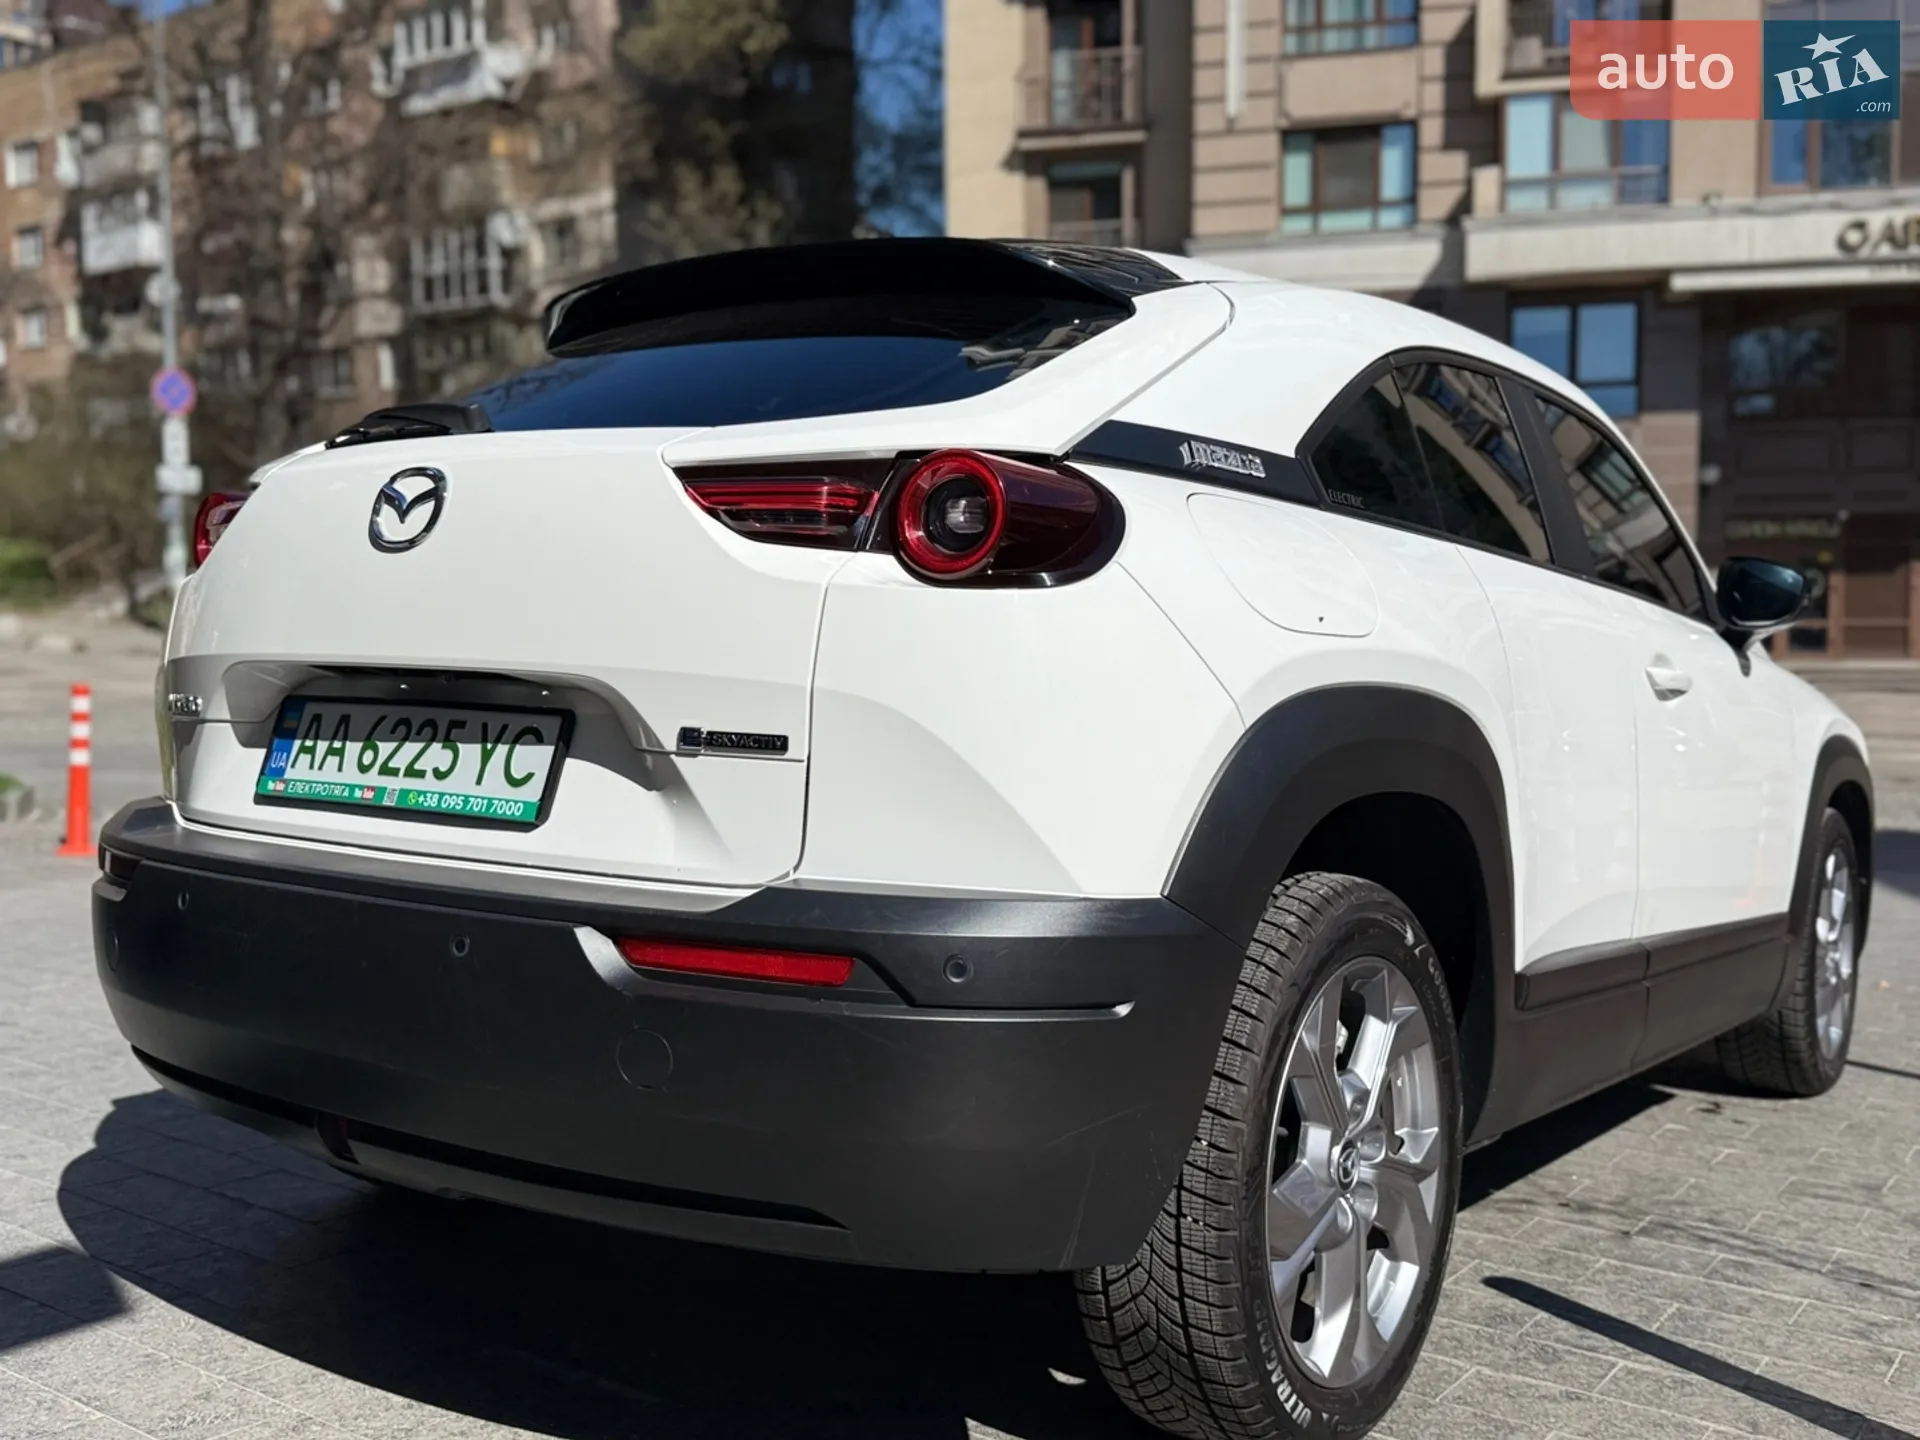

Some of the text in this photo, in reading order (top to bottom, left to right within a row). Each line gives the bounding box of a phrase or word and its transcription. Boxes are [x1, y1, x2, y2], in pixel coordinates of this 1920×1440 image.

[1327, 489, 1366, 509] ELECTRIC
[269, 751, 287, 769] UA
[290, 712, 545, 789] AA 6225 YC
[287, 781, 350, 798] ЕЛЕКТРОТЯГА
[418, 792, 524, 817] +38 095 701 7000
